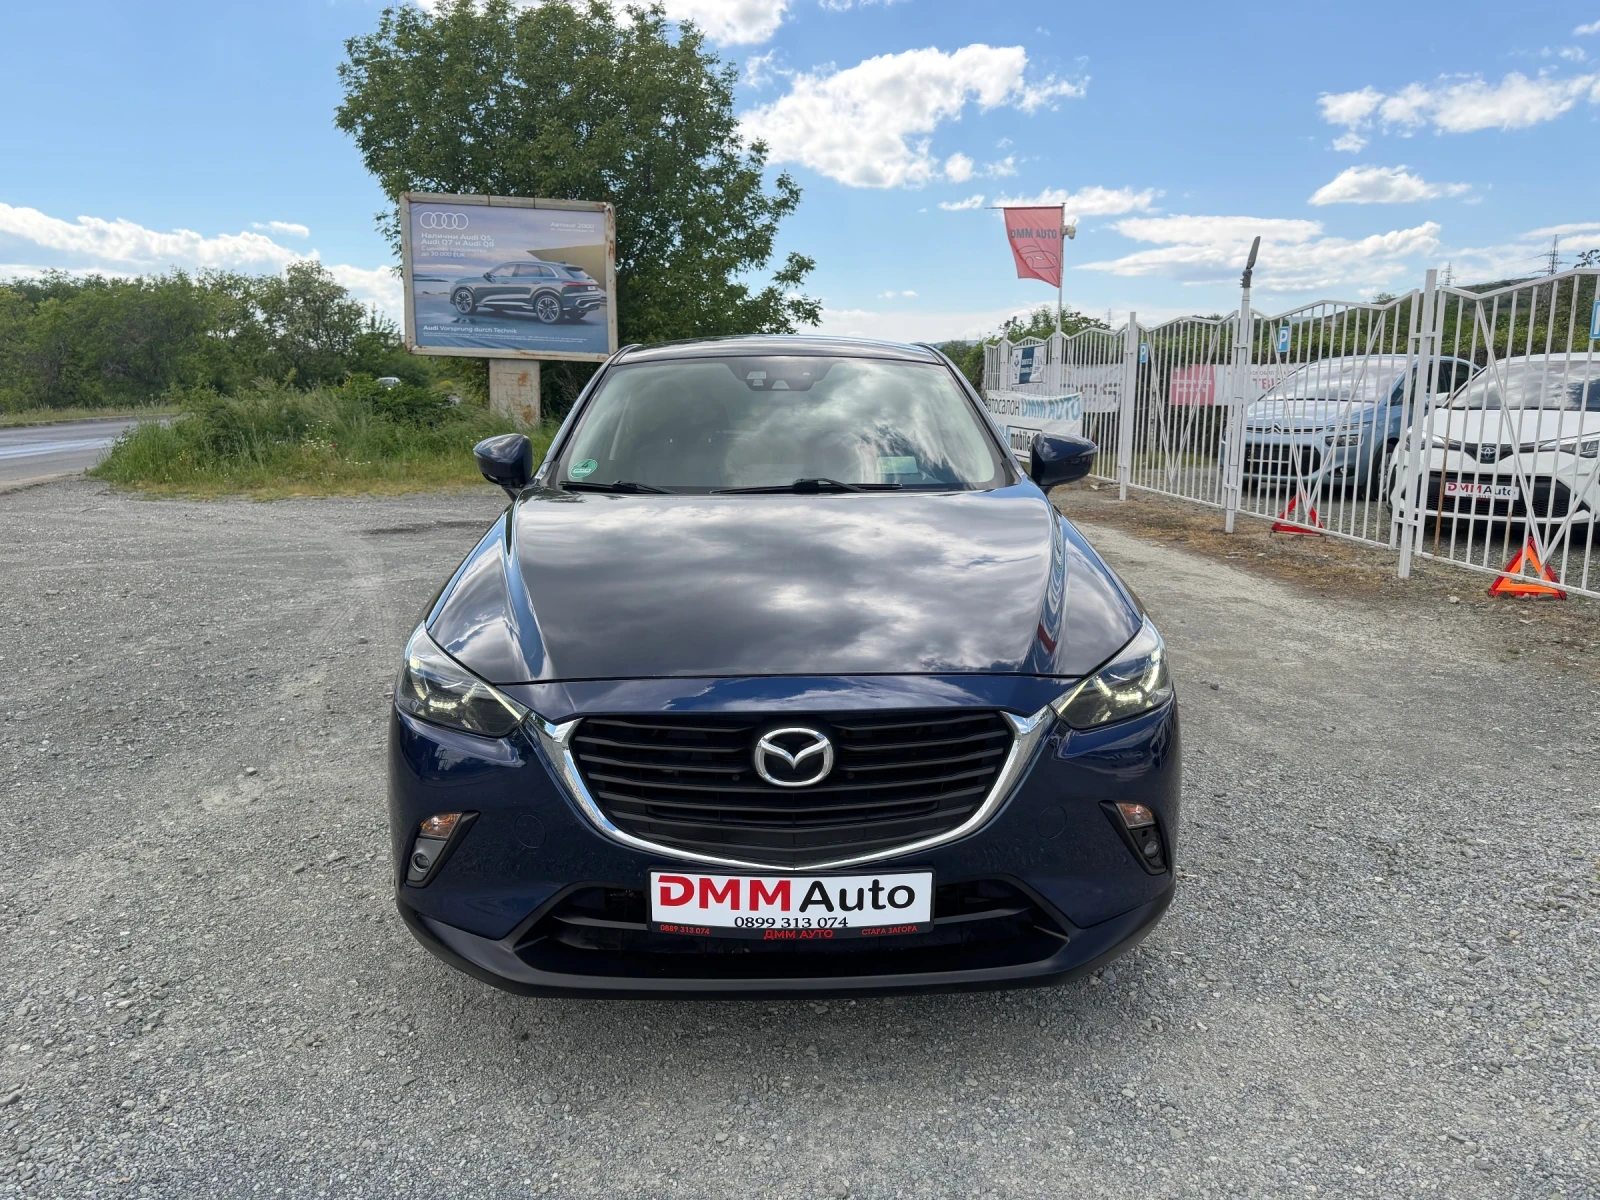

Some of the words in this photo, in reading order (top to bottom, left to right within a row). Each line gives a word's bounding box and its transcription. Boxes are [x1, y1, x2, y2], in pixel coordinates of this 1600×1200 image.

[1010, 228, 1033, 239] DMM
[1036, 229, 1057, 239] AUTO
[1279, 330, 1287, 349] P
[1022, 398, 1046, 419] DMM
[1048, 394, 1081, 420] AUTO
[658, 875, 791, 911] DMM
[799, 879, 915, 912] Auto
[734, 916, 776, 928] 0899
[781, 917, 812, 928] 313
[817, 916, 848, 928] 074
[660, 924, 678, 932] 0889
[695, 927, 710, 935] 074
[764, 930, 796, 940] ДММ
[800, 930, 834, 939] АУТО
[862, 928, 886, 936] СТАРА
[888, 925, 917, 933] ЗАГОРА
